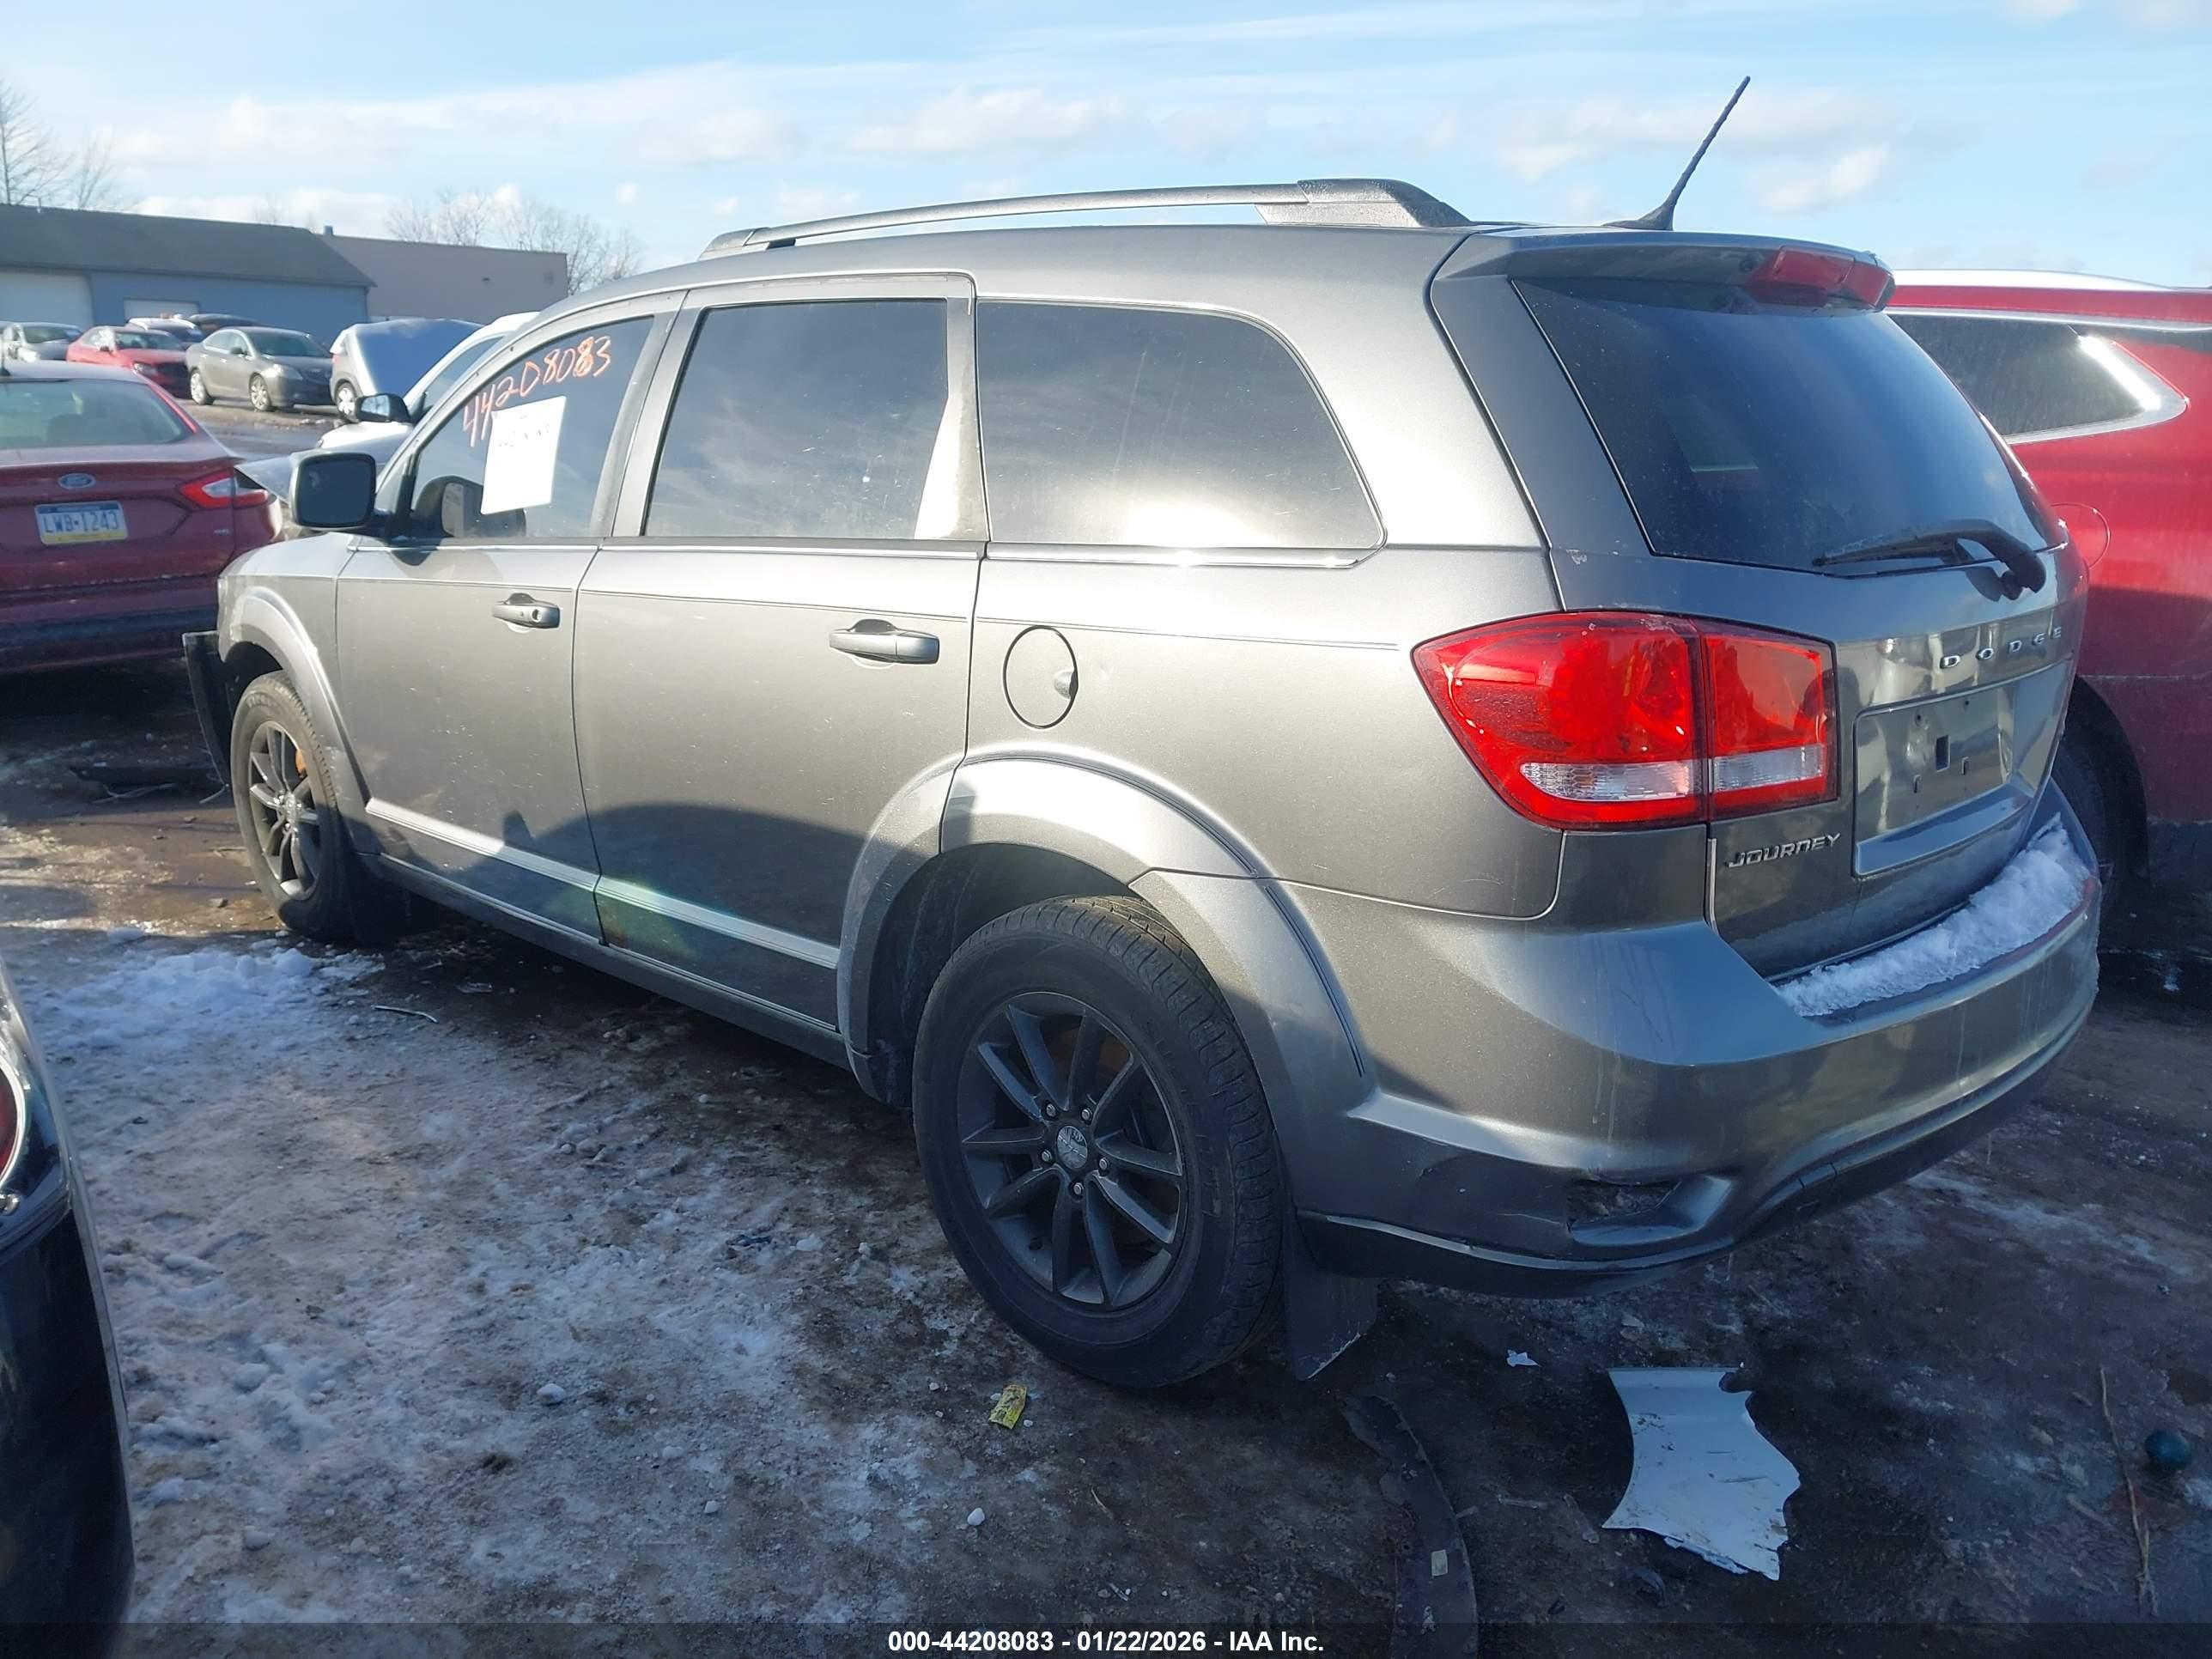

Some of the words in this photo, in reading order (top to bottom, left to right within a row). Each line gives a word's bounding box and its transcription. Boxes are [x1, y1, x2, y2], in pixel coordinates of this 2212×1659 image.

[463, 336, 612, 447] 44208083
[1941, 626, 2062, 668] DODGE
[1726, 831, 1841, 869] JOURNEY
